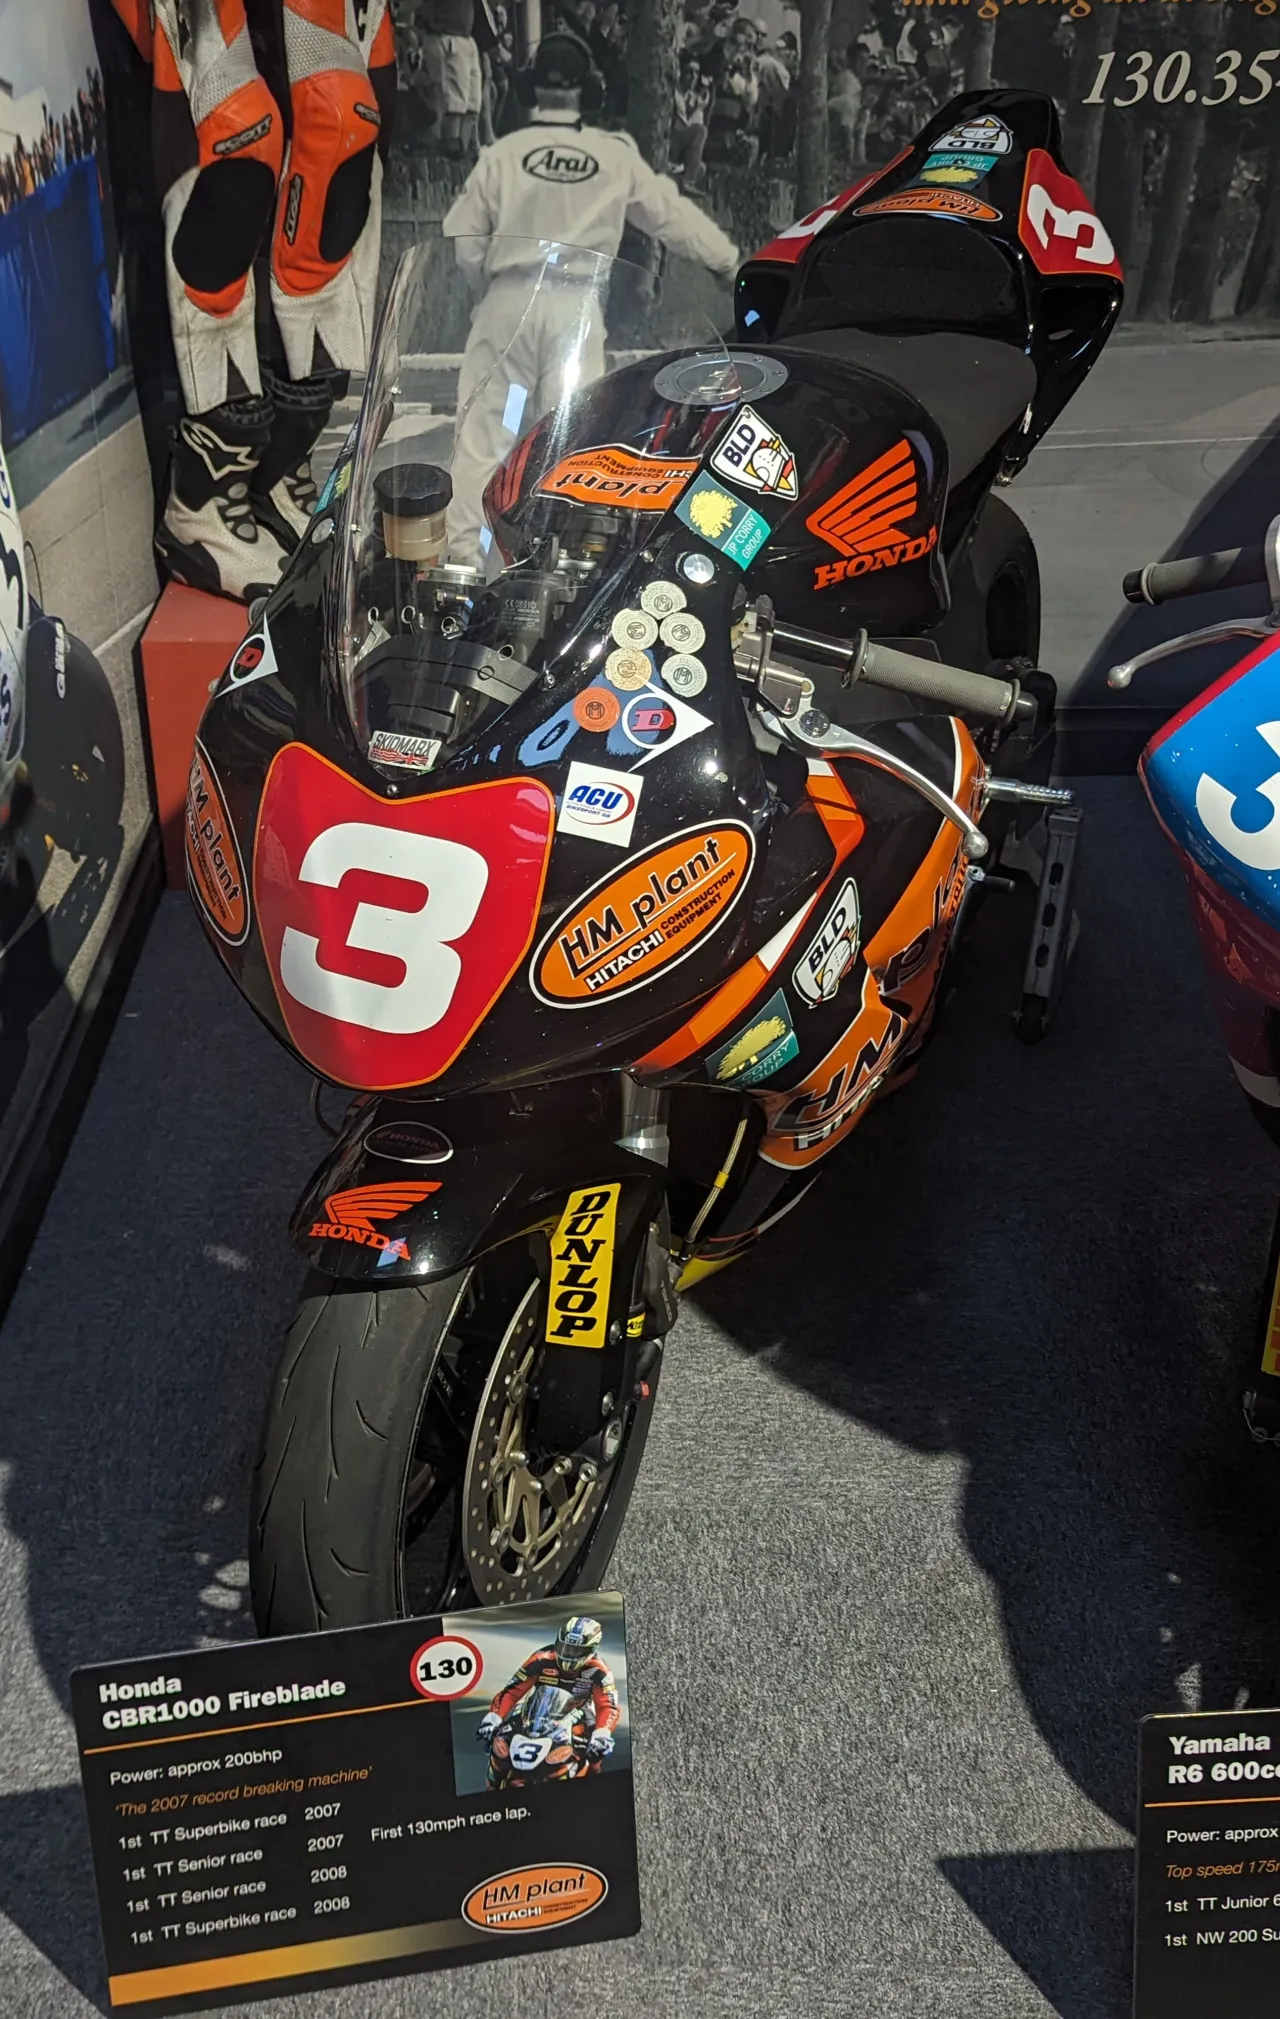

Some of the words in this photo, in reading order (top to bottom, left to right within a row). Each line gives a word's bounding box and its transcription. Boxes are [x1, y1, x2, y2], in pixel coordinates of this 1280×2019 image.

[1081, 50, 1280, 107] 130.35
[948, 140, 997, 149] BLD
[938, 200, 980, 215] HM
[1027, 184, 1115, 264] 3
[595, 454, 664, 474] EQUIPMENT
[722, 424, 756, 468] BLD
[554, 473, 670, 498] plant
[568, 461, 660, 479] CONSTRUCTION
[734, 514, 758, 546] CORRY
[741, 529, 763, 559] GROUP
[813, 525, 938, 590] HONDA
[568, 785, 623, 809] ACU
[201, 817, 239, 900] plant
[559, 905, 624, 980] HM
[630, 836, 719, 931] plant
[665, 893, 722, 939] EQUIPMENT
[280, 822, 488, 1034] 3
[585, 930, 665, 991] HITACHI
[660, 869, 736, 930] CONSTRUCTION
[807, 907, 847, 973] BLD
[309, 1223, 411, 1261] HONDA
[550, 1190, 611, 1339] DUNLOP
[420, 1657, 472, 1681] 130
[99, 1676, 182, 1703] Honda
[102, 1696, 220, 1730] CBR1000
[228, 1679, 346, 1711] Fireblade
[513, 1743, 543, 1762] 3
[1168, 1733, 1271, 1755] Yamaha
[110, 1768, 164, 1786] Power:
[168, 1757, 221, 1780] approx
[225, 1749, 282, 1768] 200bhp
[1168, 1764, 1204, 1784] R6
[151, 1795, 188, 1813] 2007
[193, 1787, 239, 1806] record
[243, 1777, 304, 1797] breaking
[119, 1835, 142, 1850] 1st
[150, 1829, 170, 1845] TT
[175, 1818, 250, 1842] Superbike
[254, 1813, 287, 1828] race
[305, 1803, 341, 1821] 2007
[123, 1867, 146, 1882] 1st
[154, 1861, 174, 1877] TT
[178, 1855, 226, 1873] Senior
[230, 1849, 262, 1864] race
[307, 1834, 344, 1852] 2007
[371, 1825, 402, 1842] First
[407, 1815, 466, 1836] 130mph
[470, 1811, 501, 1826] race
[505, 1807, 531, 1820] lap.
[1166, 1830, 1220, 1843] Power:
[1225, 1827, 1279, 1842] approx
[126, 1898, 150, 1913] 1st
[157, 1893, 178, 1908] TT
[182, 1887, 229, 1905] Senior
[233, 1880, 266, 1896] race
[311, 1865, 347, 1883] 2008
[1166, 1865, 1192, 1880] Top
[1196, 1862, 1244, 1878] speed
[483, 1882, 521, 1911] HM
[526, 1871, 587, 1903] plant
[1165, 1900, 1188, 1912] 1st
[1196, 1897, 1218, 1910] TT
[1221, 1895, 1269, 1909] Junior
[131, 1930, 153, 1945] 1st
[161, 1924, 180, 1939] TT
[185, 1913, 260, 1936] Superbike
[264, 1907, 297, 1922] race
[313, 1896, 350, 1914] 2008
[486, 1906, 542, 1925] HITACHI
[1165, 1934, 1187, 1946] 1st
[1196, 1931, 1225, 1945] NW
[1229, 1929, 1257, 1943] 200
